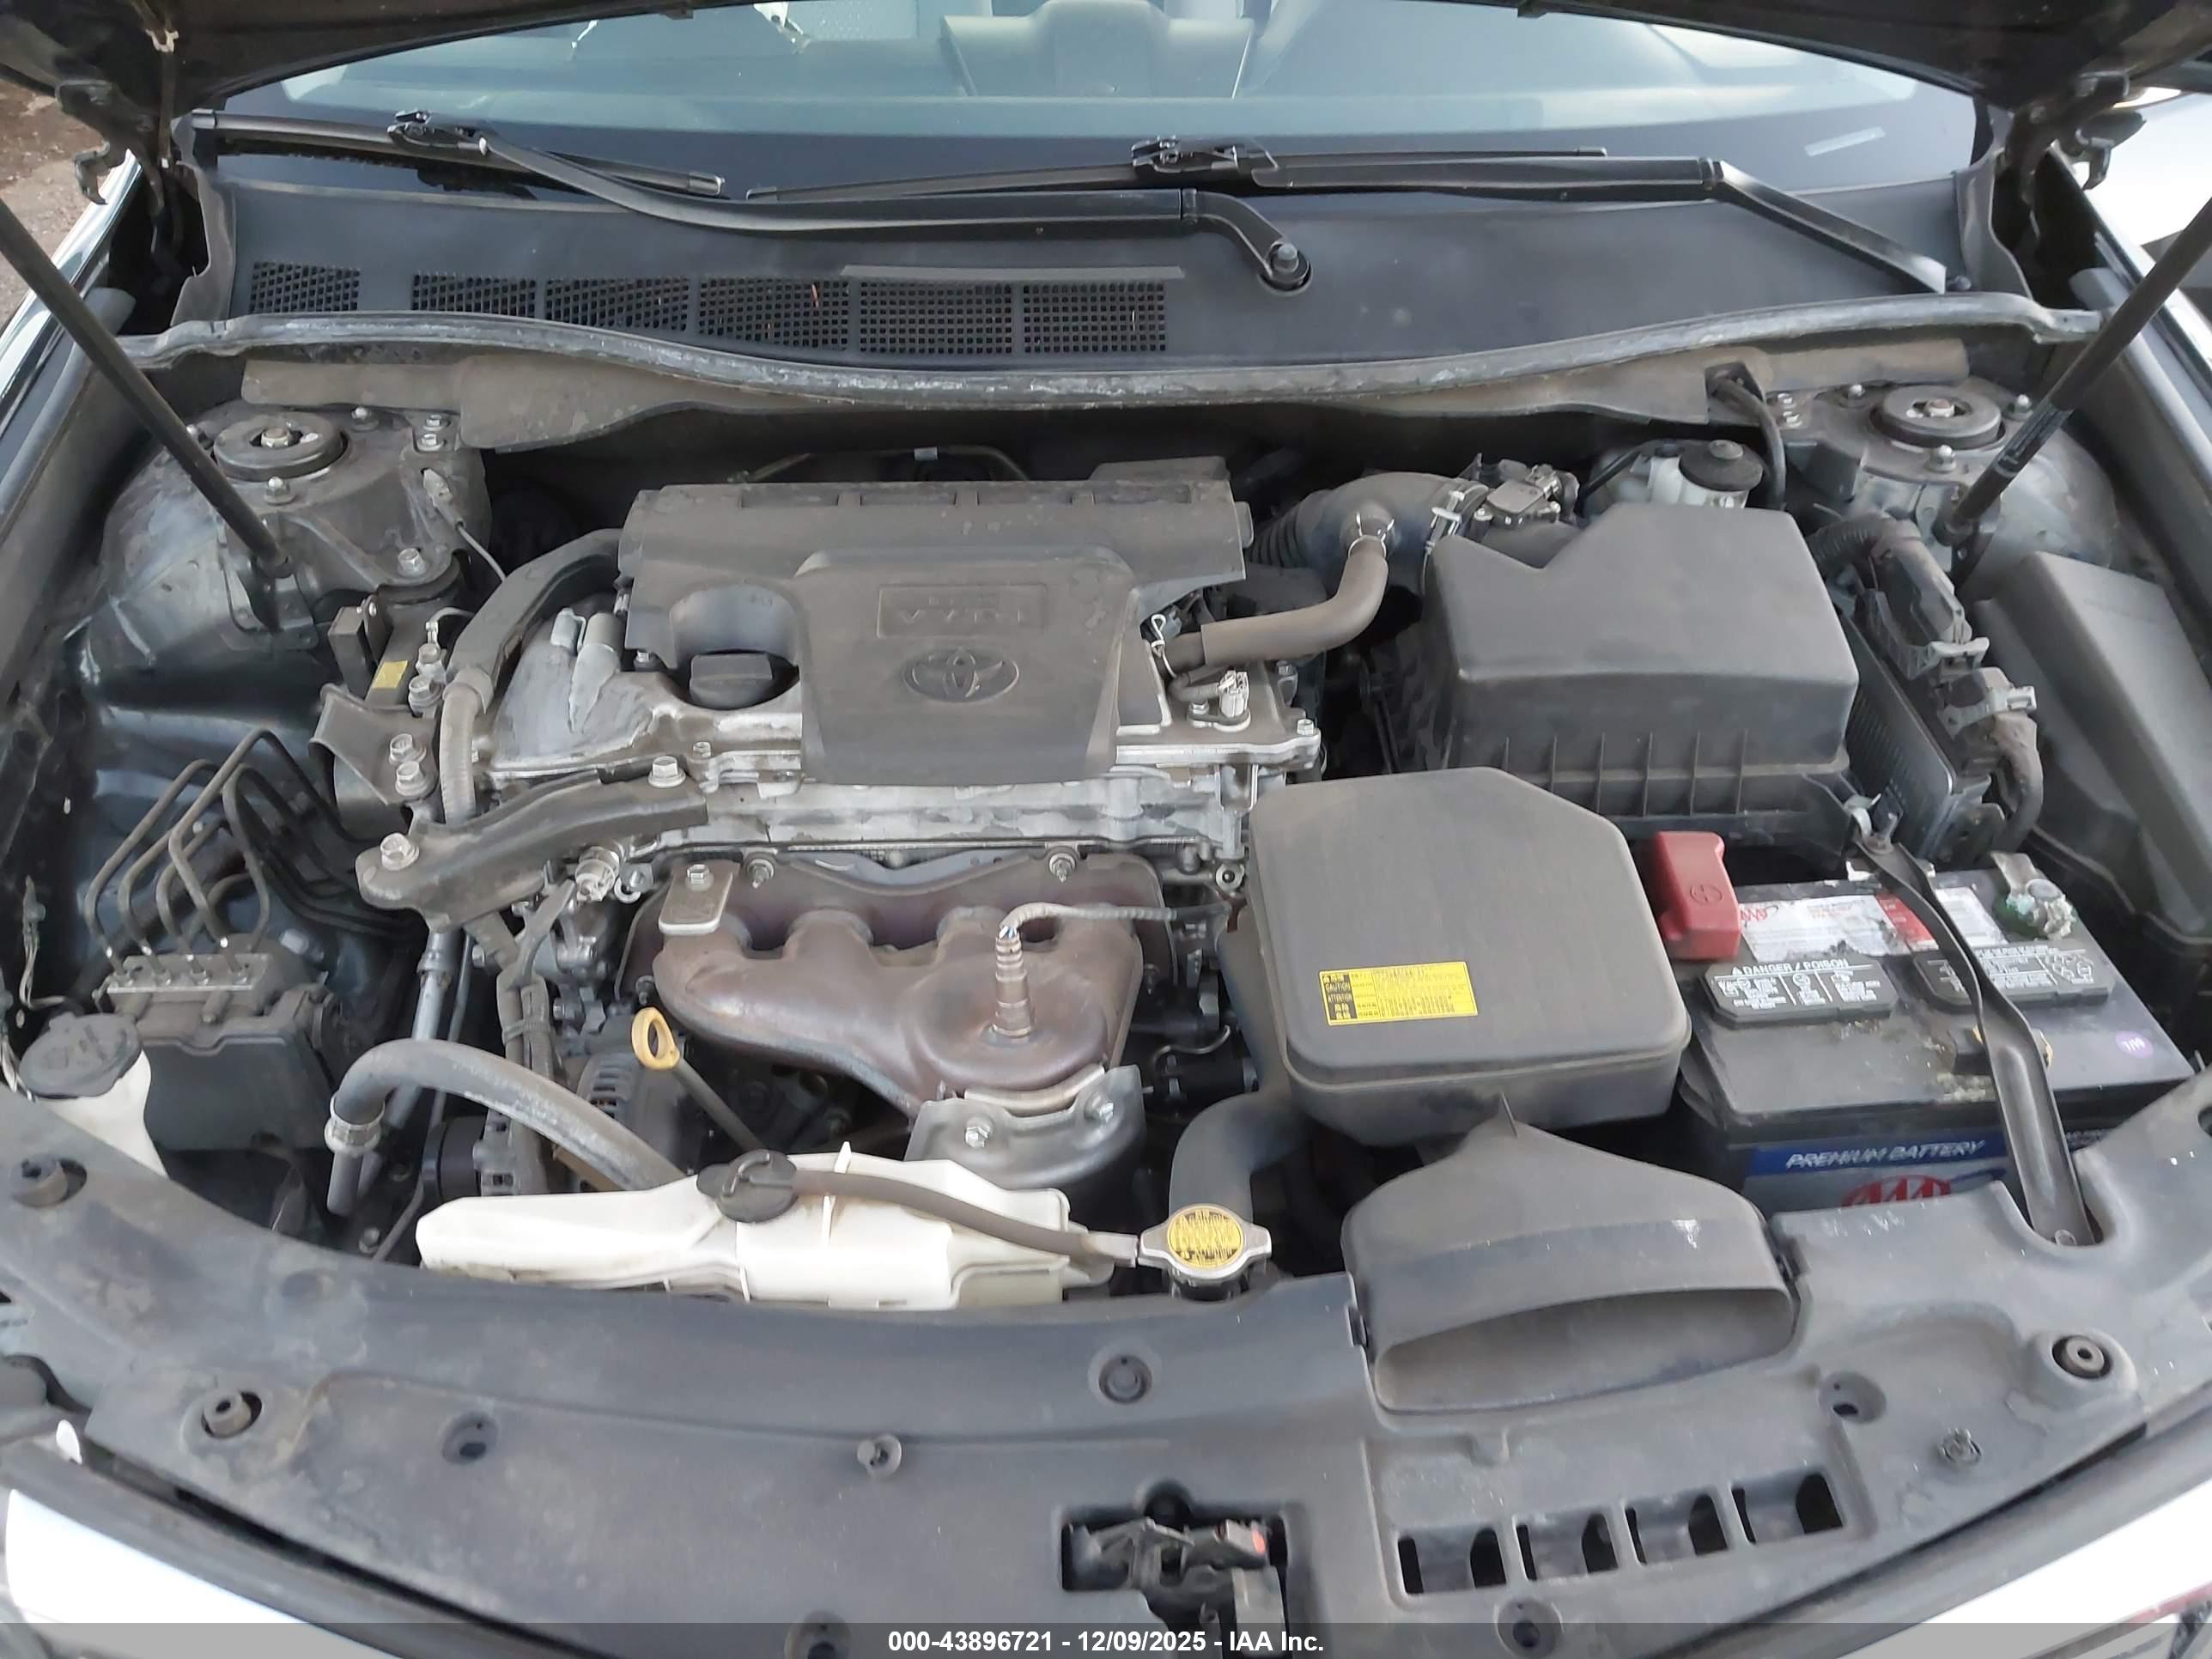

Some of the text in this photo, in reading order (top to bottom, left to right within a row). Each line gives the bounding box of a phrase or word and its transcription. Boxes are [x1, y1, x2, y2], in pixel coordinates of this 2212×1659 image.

[1743, 963, 1794, 975] DANGER
[1803, 958, 1849, 970] POISON
[1325, 981, 1351, 993] CAUTION
[1786, 1139, 1985, 1168] PREMIUM BATTERY
